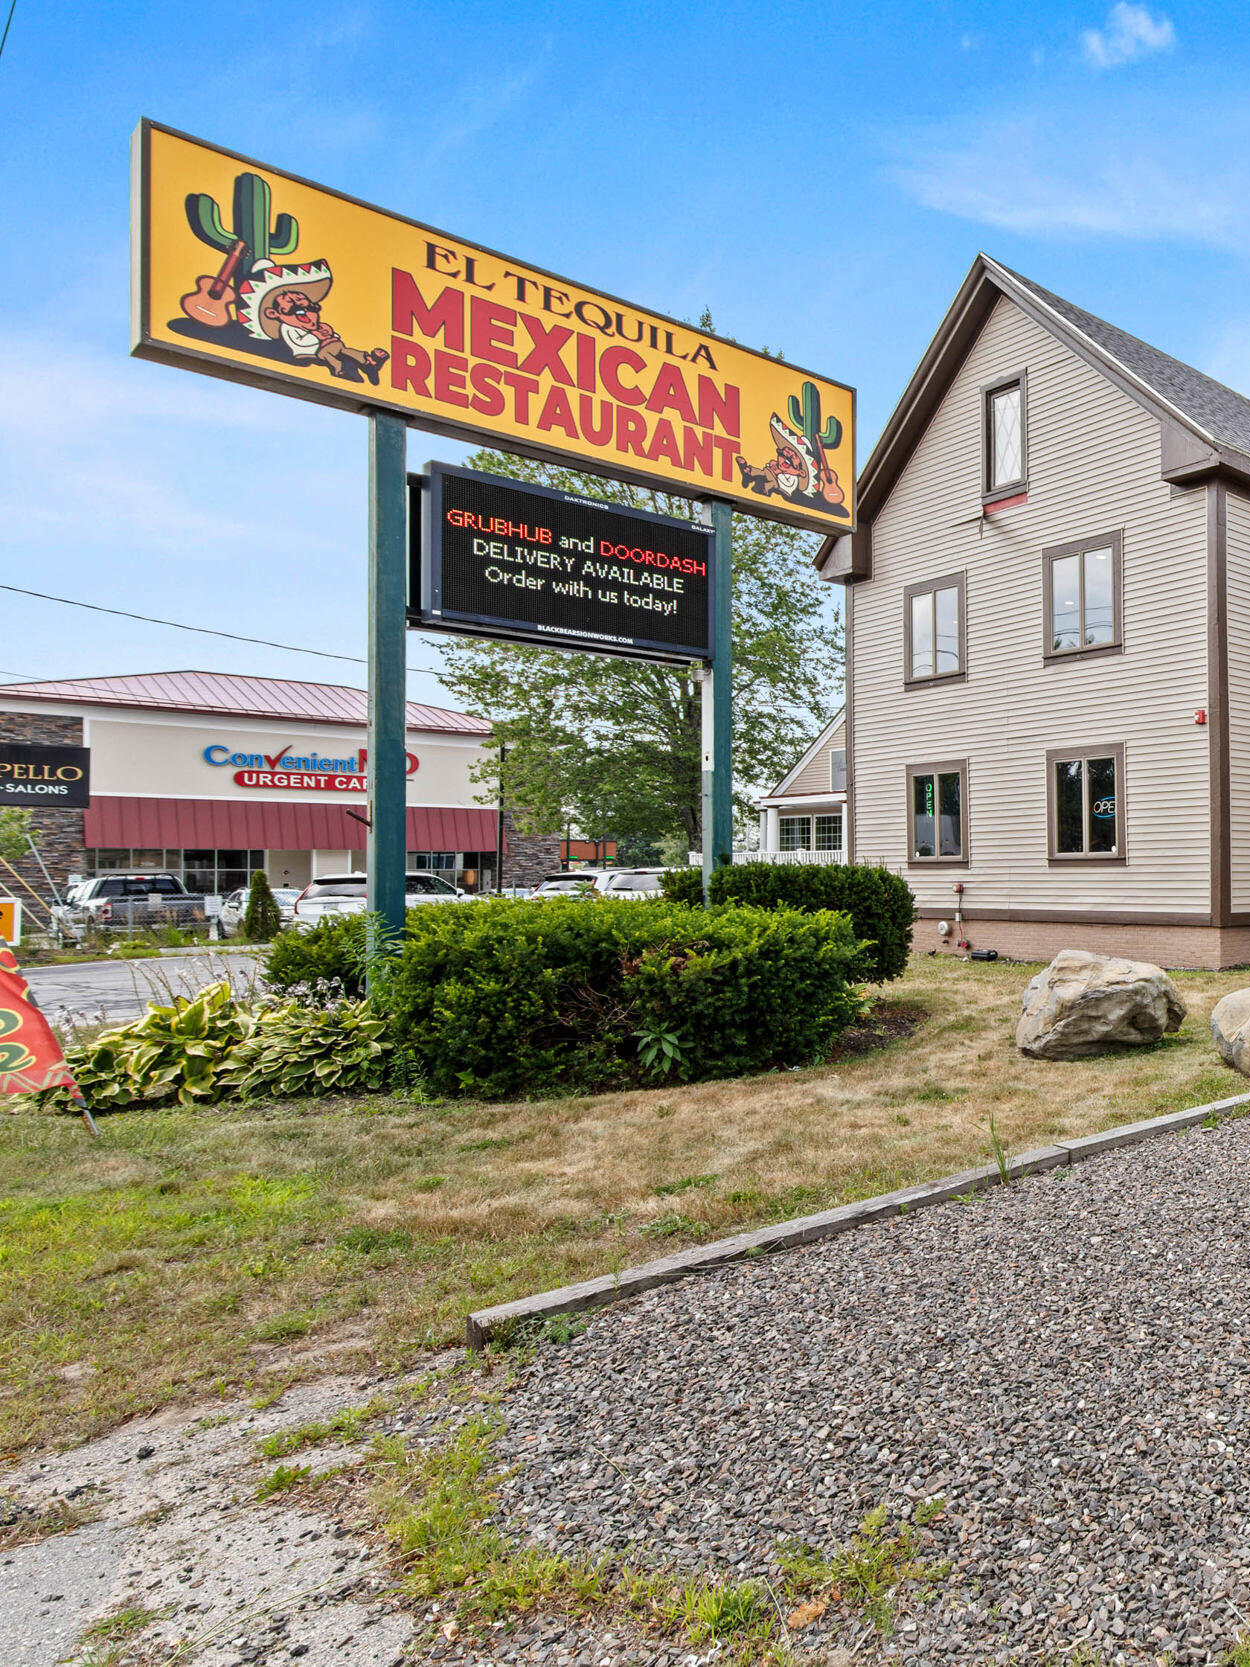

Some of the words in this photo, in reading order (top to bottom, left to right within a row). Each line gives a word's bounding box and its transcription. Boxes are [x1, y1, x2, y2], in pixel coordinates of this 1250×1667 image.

[423, 240, 496, 291] EL
[503, 270, 719, 371] TEQUILA
[391, 266, 741, 439] MEXICAN
[391, 335, 741, 482] RESTAURANT
[564, 495, 609, 510] DAKTRONICS
[447, 509, 552, 544] GRUBHUB
[558, 536, 594, 554] and
[600, 541, 706, 576] DOORDASH
[473, 538, 575, 573] DELIVERY
[582, 560, 685, 594] AVAILABLE
[485, 565, 546, 590] Order
[552, 581, 592, 599] with
[598, 589, 618, 604] us
[624, 590, 678, 616] today!
[243, 772, 329, 789] URGENT
[334, 776, 368, 790] CA
[925, 783, 933, 818] OPEN
[1093, 800, 1116, 814] OPE
